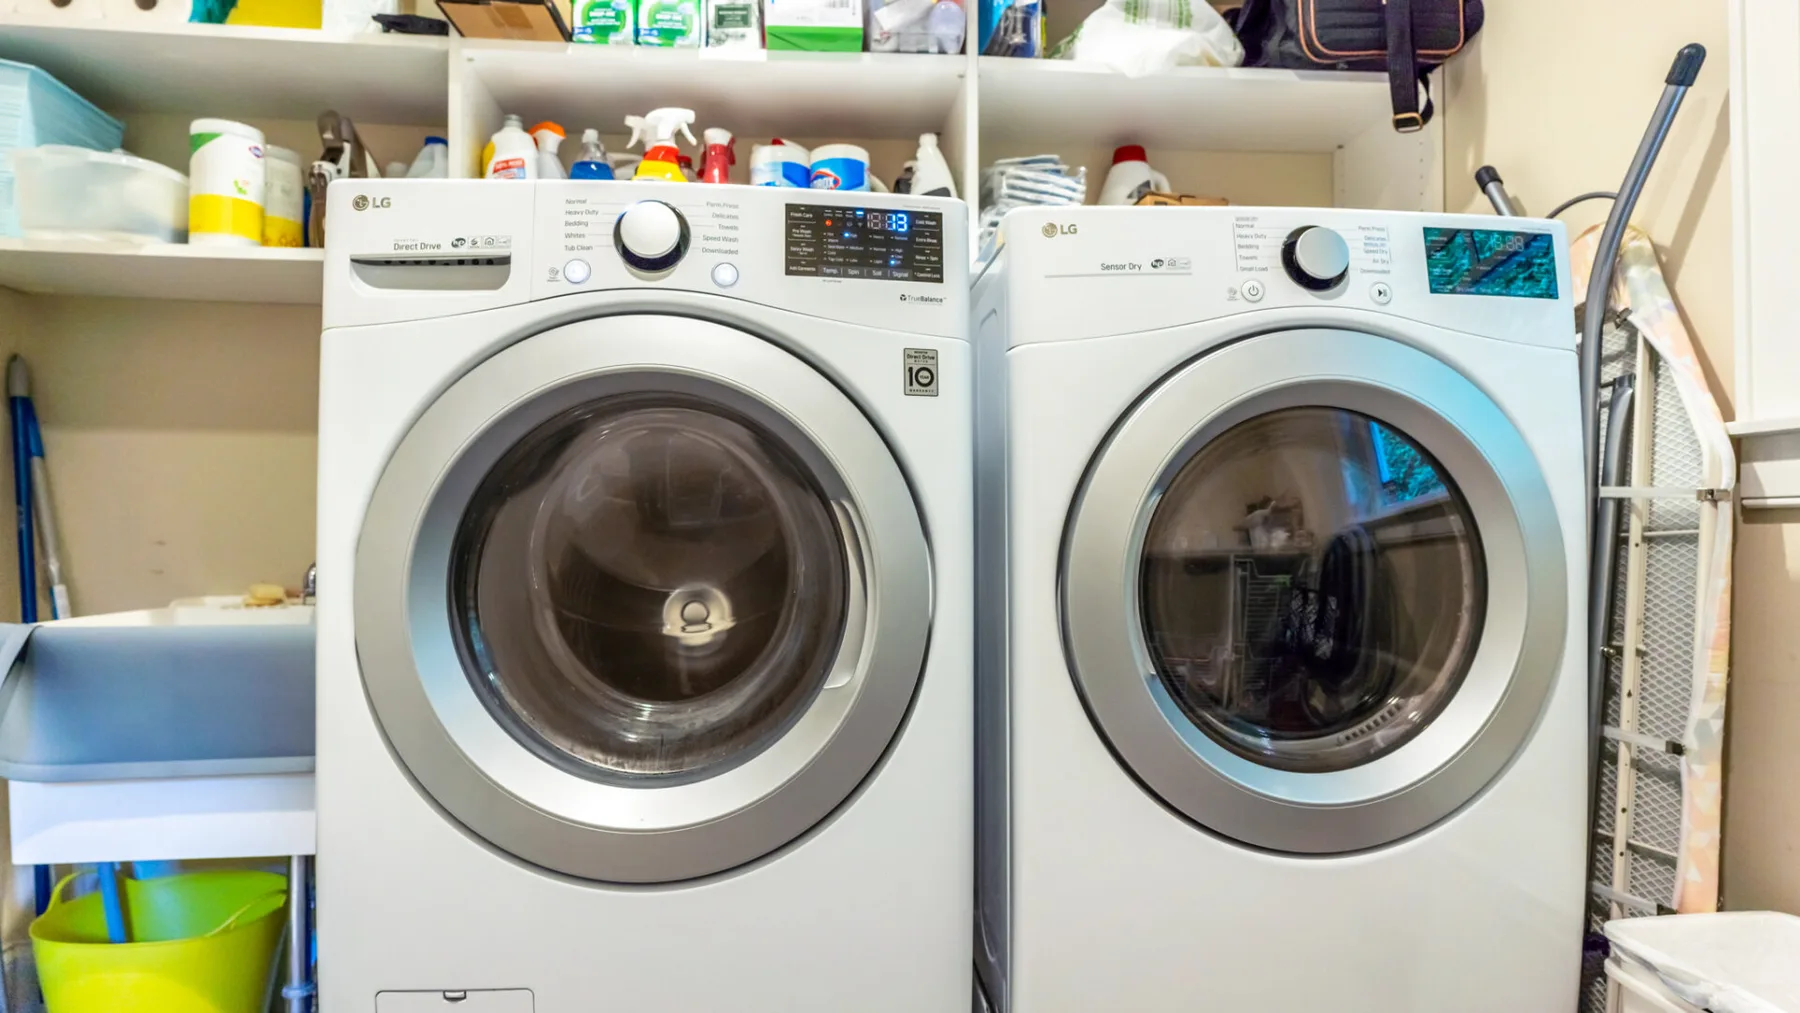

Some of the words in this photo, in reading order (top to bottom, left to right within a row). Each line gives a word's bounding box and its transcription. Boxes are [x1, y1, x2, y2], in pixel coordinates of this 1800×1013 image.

[371, 196, 392, 209] LG
[584, 208, 599, 216] Duty
[712, 211, 739, 220] Delicates
[564, 220, 589, 228] Bedding
[718, 223, 739, 231] Towels
[1060, 223, 1078, 235] LG
[702, 234, 721, 243] Speed
[393, 242, 418, 250] Direct
[420, 241, 442, 250] Drive
[701, 247, 739, 255] Downloaded
[1100, 262, 1127, 271] Sensor
[1128, 262, 1142, 272] Dry
[847, 268, 860, 276] Spin
[872, 269, 883, 277] Soil
[908, 366, 934, 387] 10
